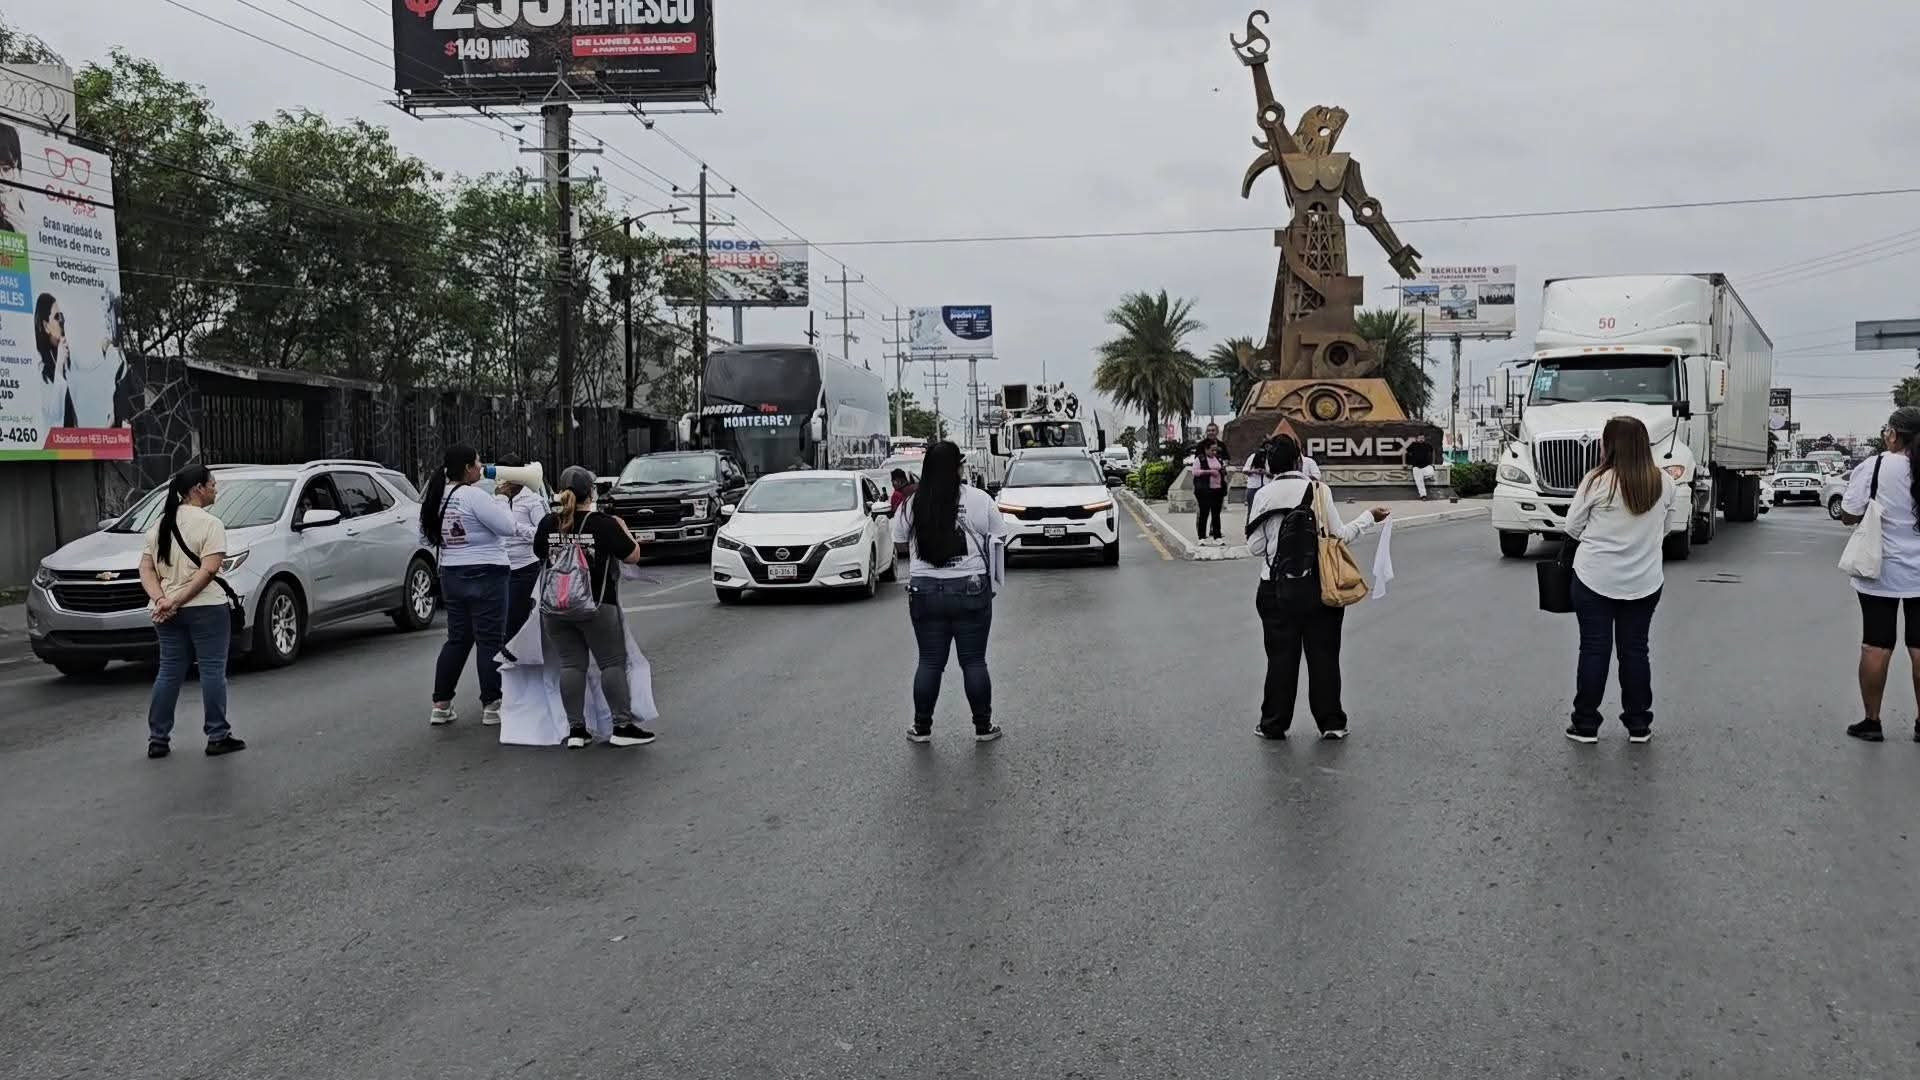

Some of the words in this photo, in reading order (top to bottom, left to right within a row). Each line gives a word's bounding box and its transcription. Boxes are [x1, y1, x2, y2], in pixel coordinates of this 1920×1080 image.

[572, 0, 695, 25] REFRESCO
[444, 38, 490, 60] $149
[491, 36, 530, 59] NIÑOS
[593, 37, 631, 46] LUNES
[633, 37, 642, 45] A
[643, 35, 692, 44] SÁBADO
[43, 216, 60, 231] Gran
[62, 223, 93, 239] variedad
[94, 229, 103, 240] de
[39, 231, 68, 249] lentes
[69, 238, 82, 252] de
[83, 241, 110, 257] marca
[56, 256, 96, 274] Licenciada
[1431, 266, 1487, 274] BACHILLERATO
[50, 271, 60, 280] en
[1599, 317, 1616, 329] 50
[702, 404, 744, 415] NORESTE
[723, 415, 792, 428] MONTERREY
[1307, 437, 1413, 456] PEMEX
